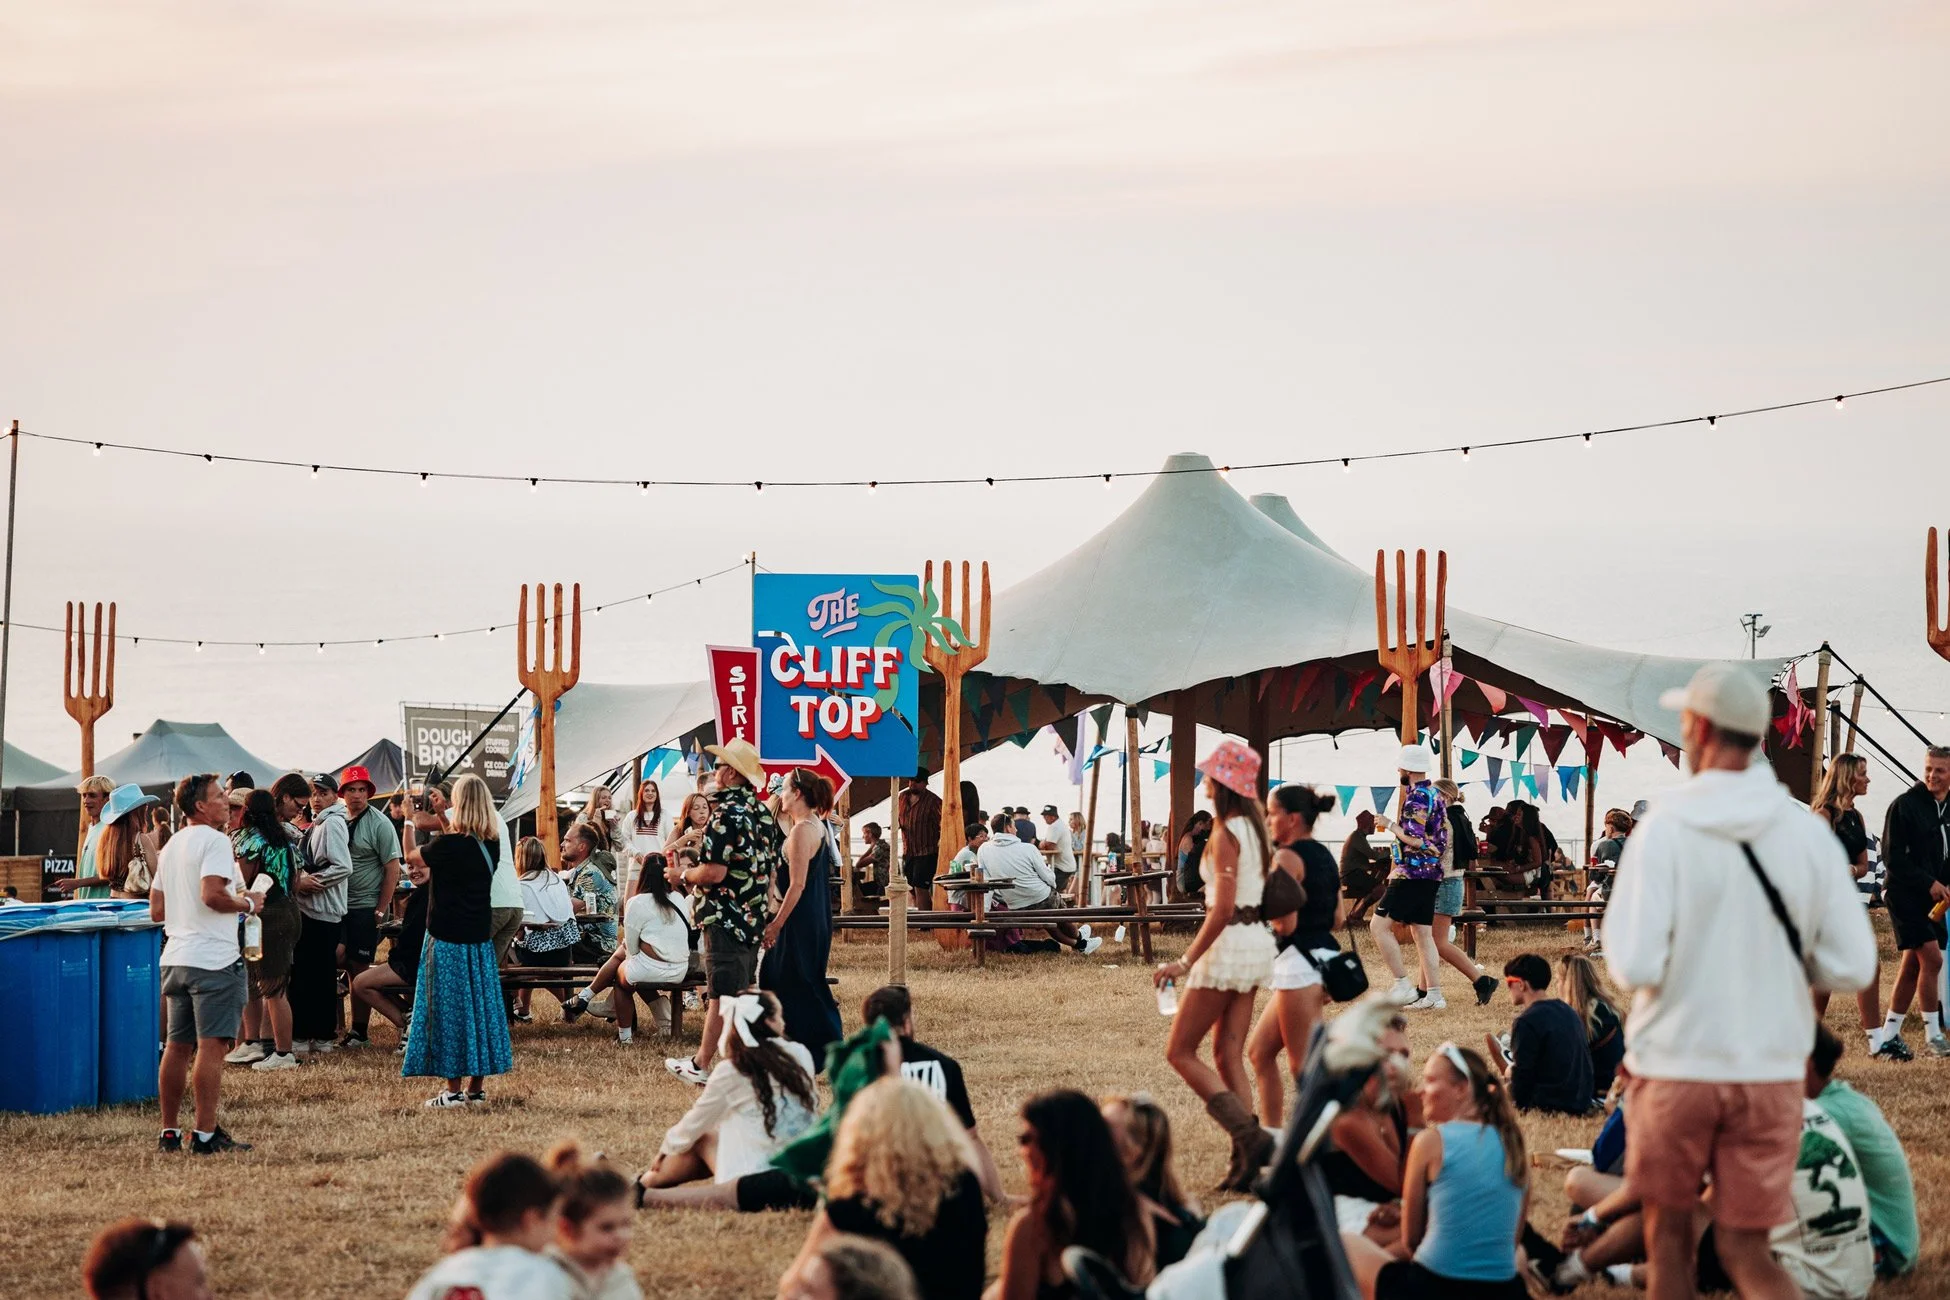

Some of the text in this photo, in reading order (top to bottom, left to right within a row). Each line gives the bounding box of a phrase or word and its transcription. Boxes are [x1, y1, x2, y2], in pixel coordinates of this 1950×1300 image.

[807, 587, 860, 632] THE
[770, 645, 902, 689] CLIFF
[729, 666, 747, 740] STRE
[791, 695, 882, 739] TOP
[417, 728, 472, 746] DOUGH
[485, 746, 510, 754] COOKIES
[484, 760, 509, 769] ICE COLD
[44, 859, 75, 873] PIZZA
